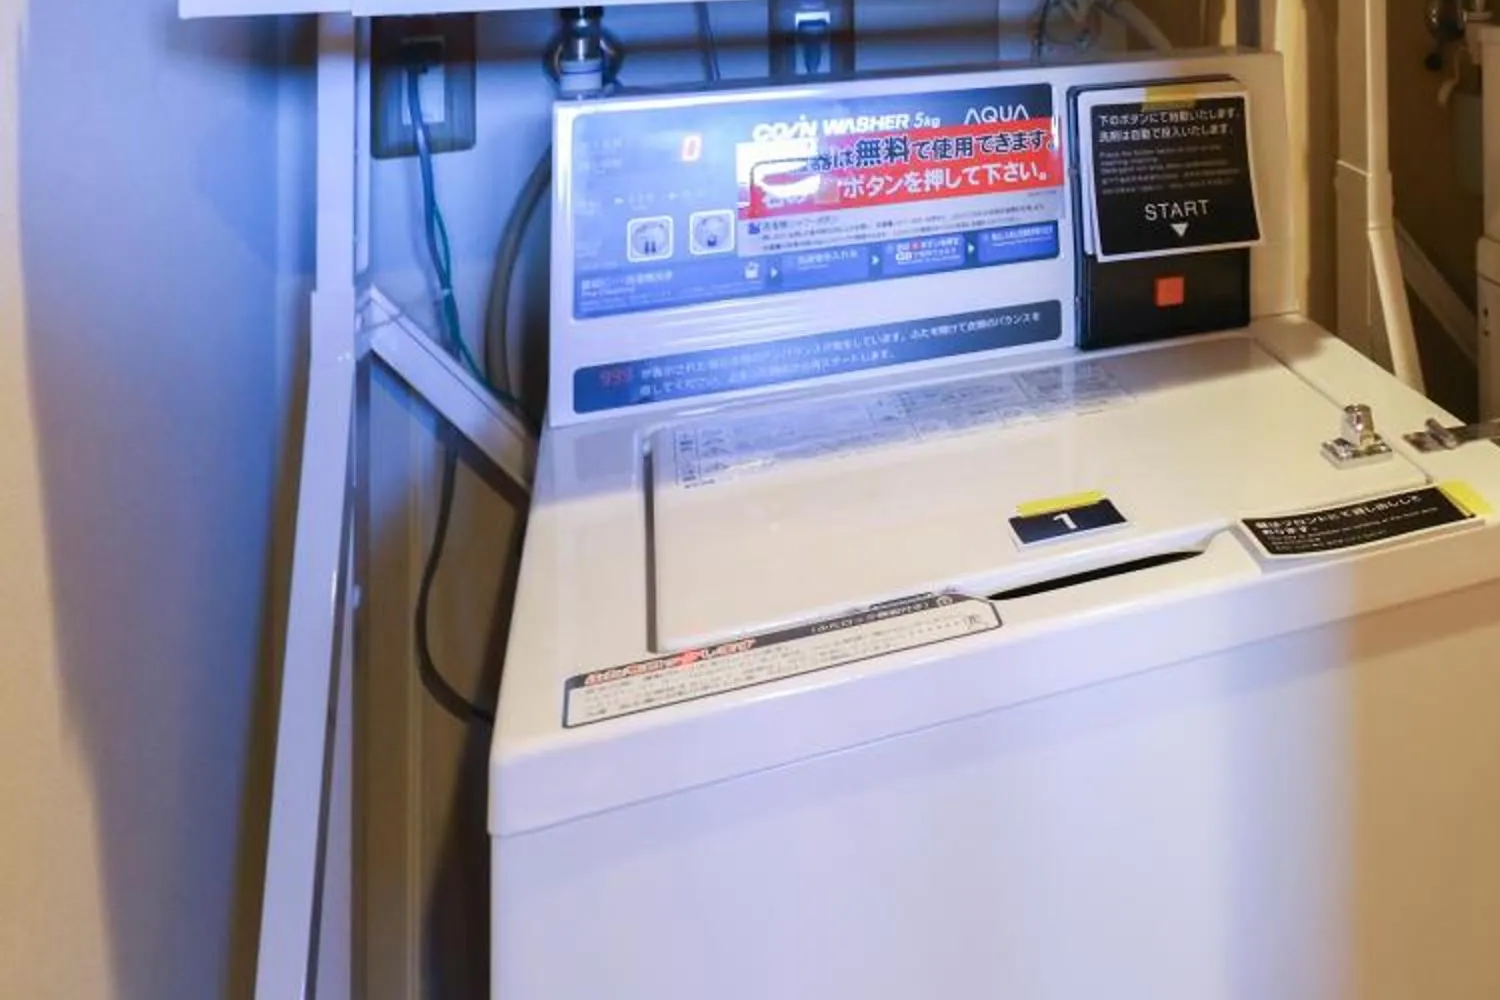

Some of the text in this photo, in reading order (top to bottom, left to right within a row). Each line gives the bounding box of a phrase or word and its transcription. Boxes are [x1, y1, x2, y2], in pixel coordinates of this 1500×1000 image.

[964, 104, 1030, 125] AQUA
[752, 114, 819, 141] COIN
[824, 114, 909, 136] WASHER
[681, 133, 702, 162] 0
[841, 162, 1047, 198] ボタンを押して下さい。
[1144, 200, 1209, 221] START
[1053, 513, 1077, 530] 1
